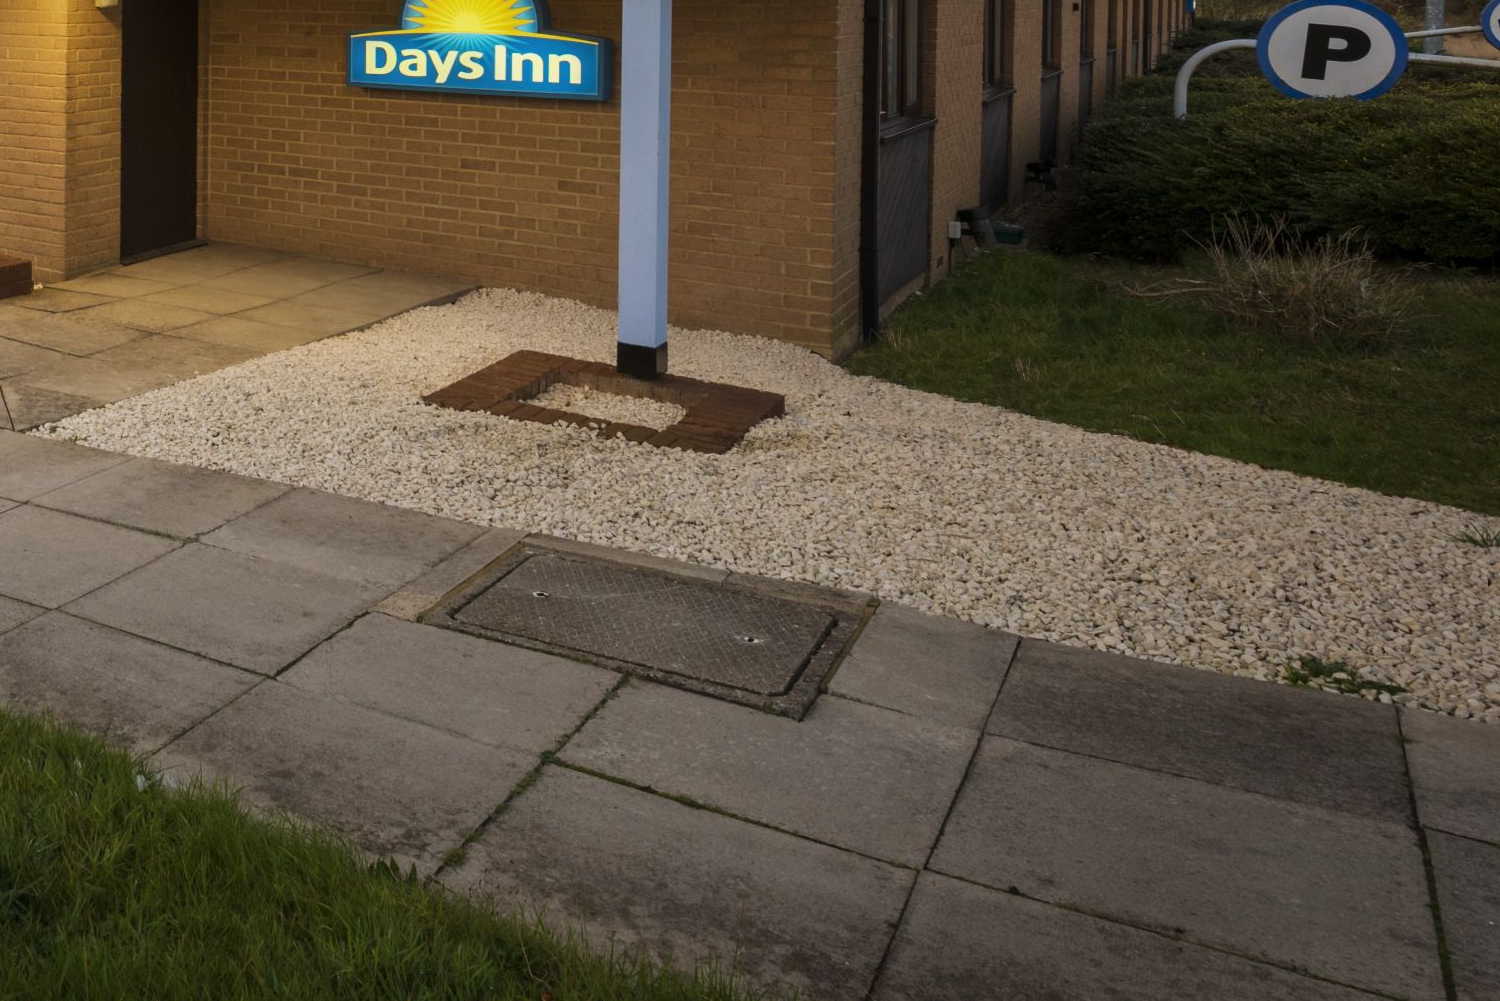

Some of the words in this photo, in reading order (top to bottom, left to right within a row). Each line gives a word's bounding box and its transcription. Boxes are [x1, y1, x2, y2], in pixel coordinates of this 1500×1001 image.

[365, 40, 485, 84] Days
[494, 44, 582, 85] Inn
[1301, 23, 1372, 81] P
